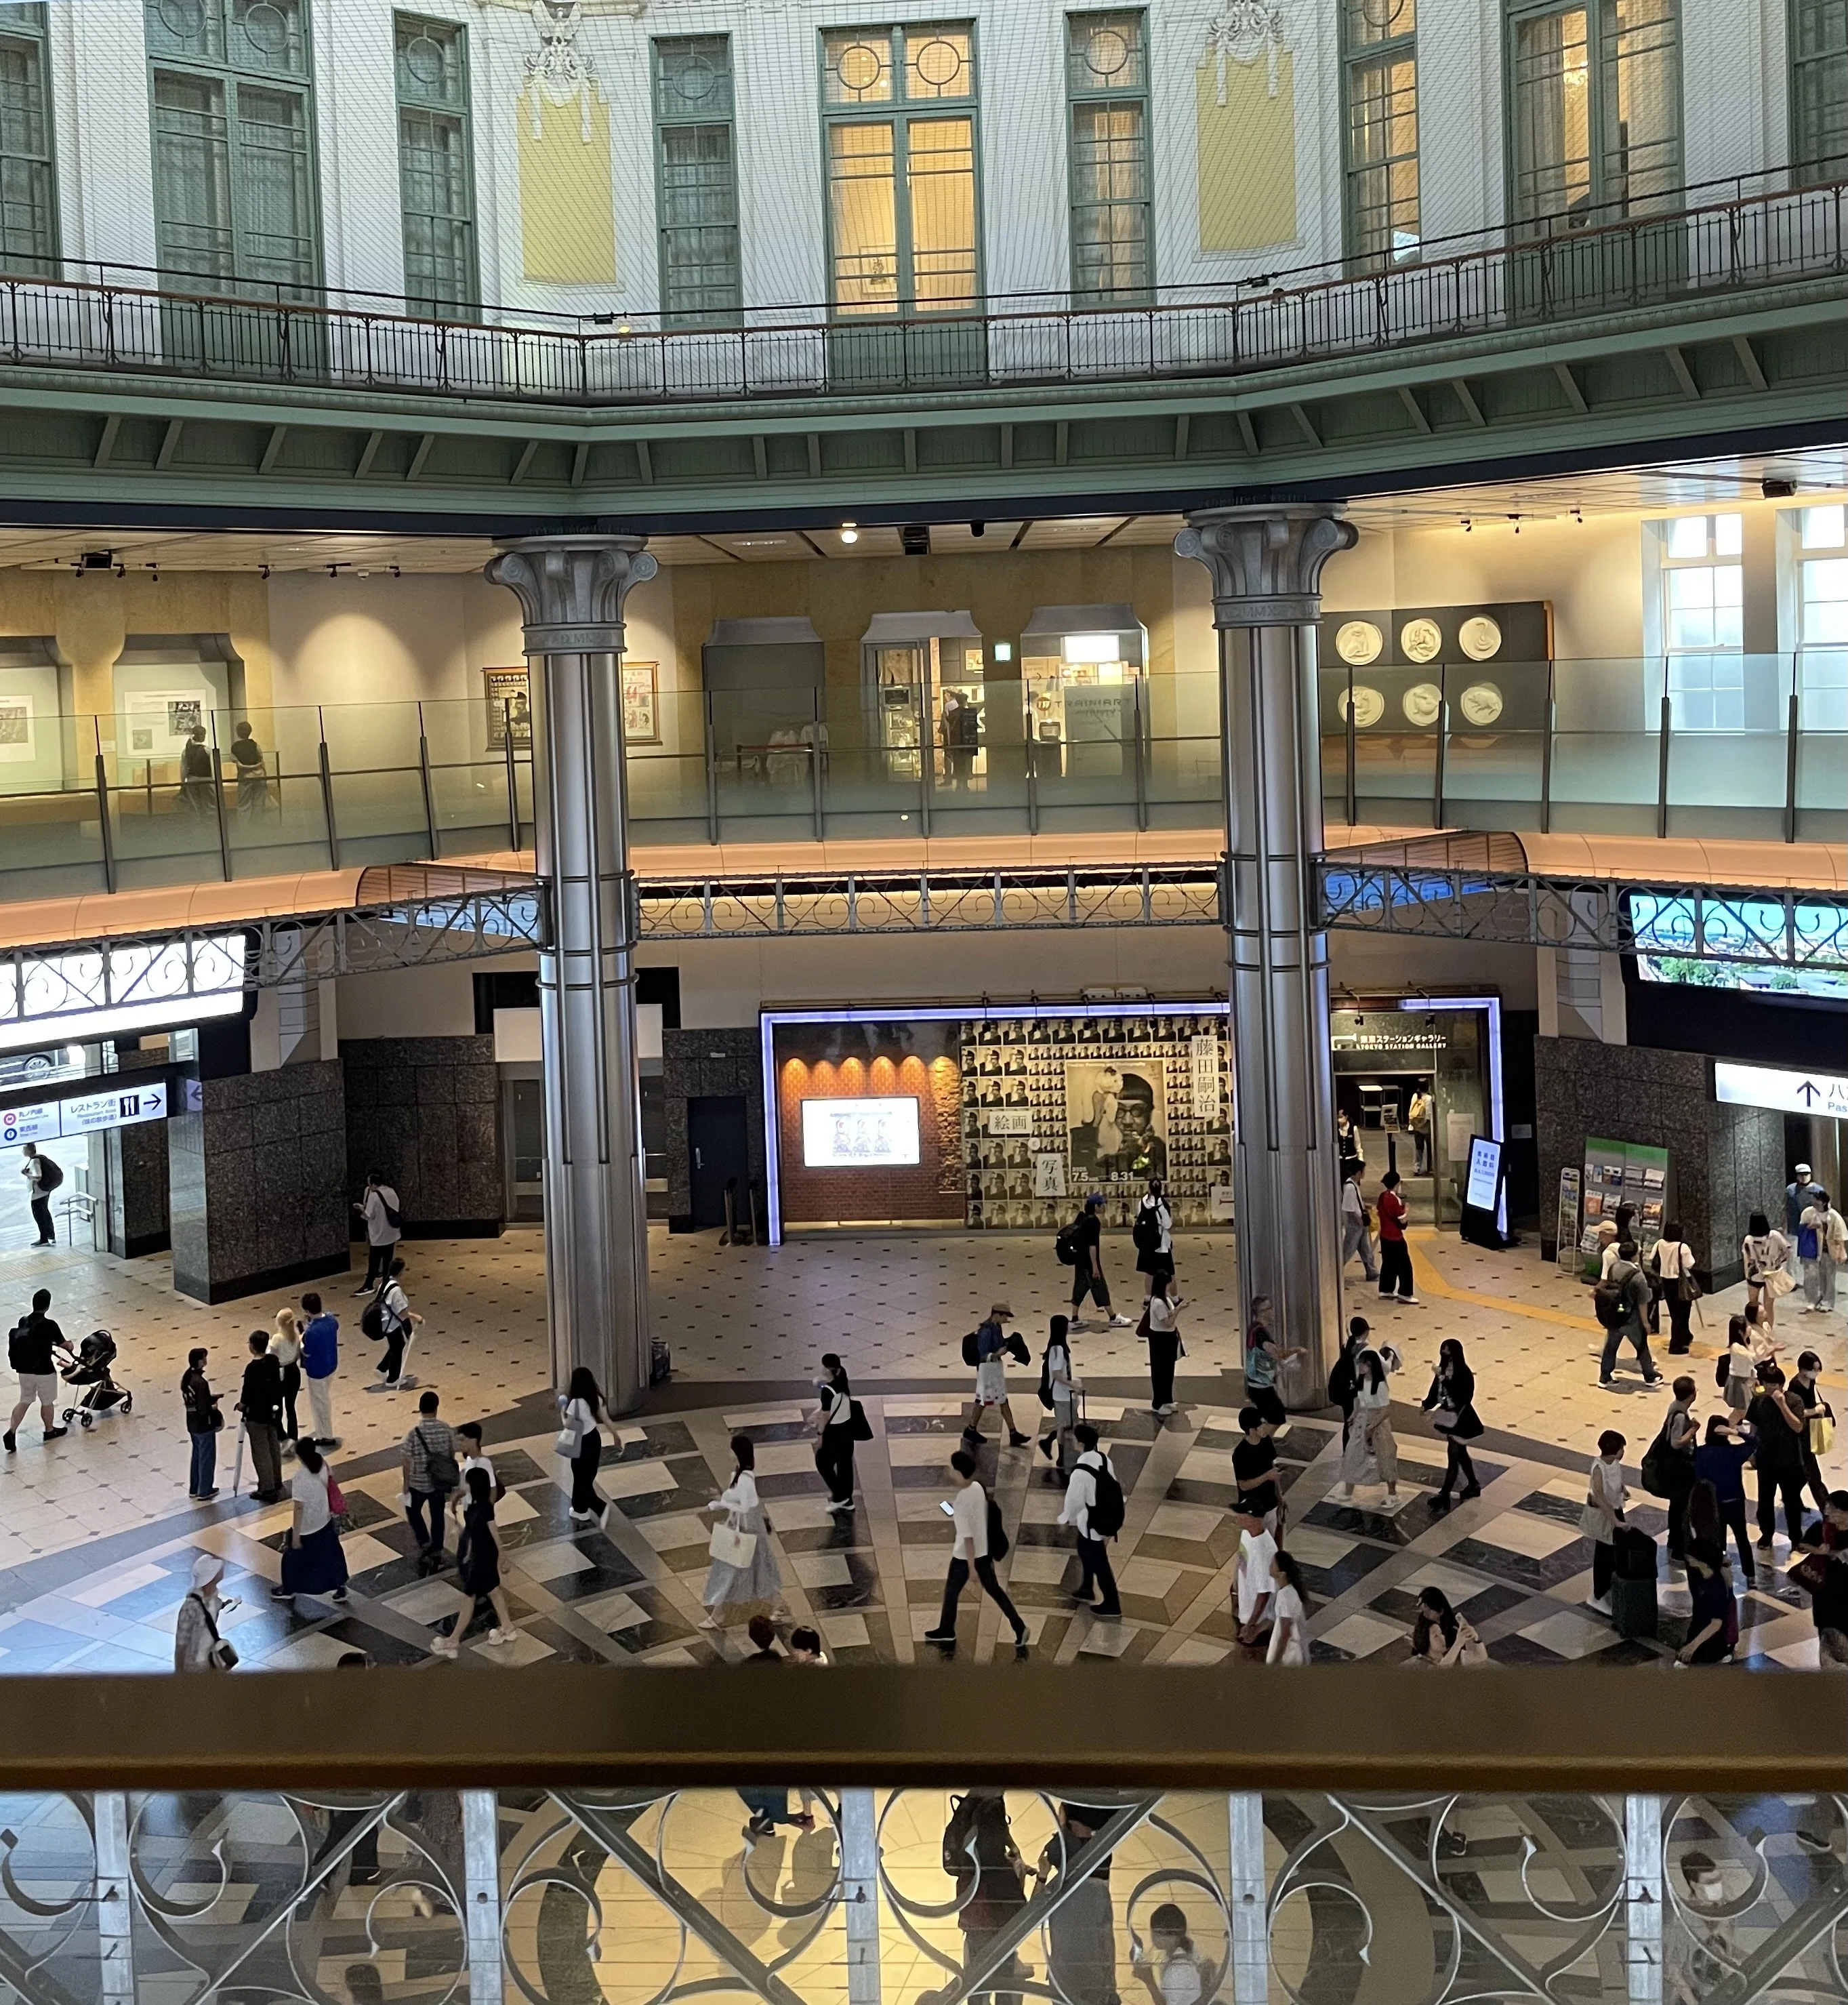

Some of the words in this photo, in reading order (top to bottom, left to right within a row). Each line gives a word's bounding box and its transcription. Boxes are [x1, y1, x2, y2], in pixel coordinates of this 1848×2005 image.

[1195, 1038, 1216, 1113] 藤田嗣治
[994, 1114, 1027, 1131] 絵画
[1042, 1159, 1059, 1192] 写真
